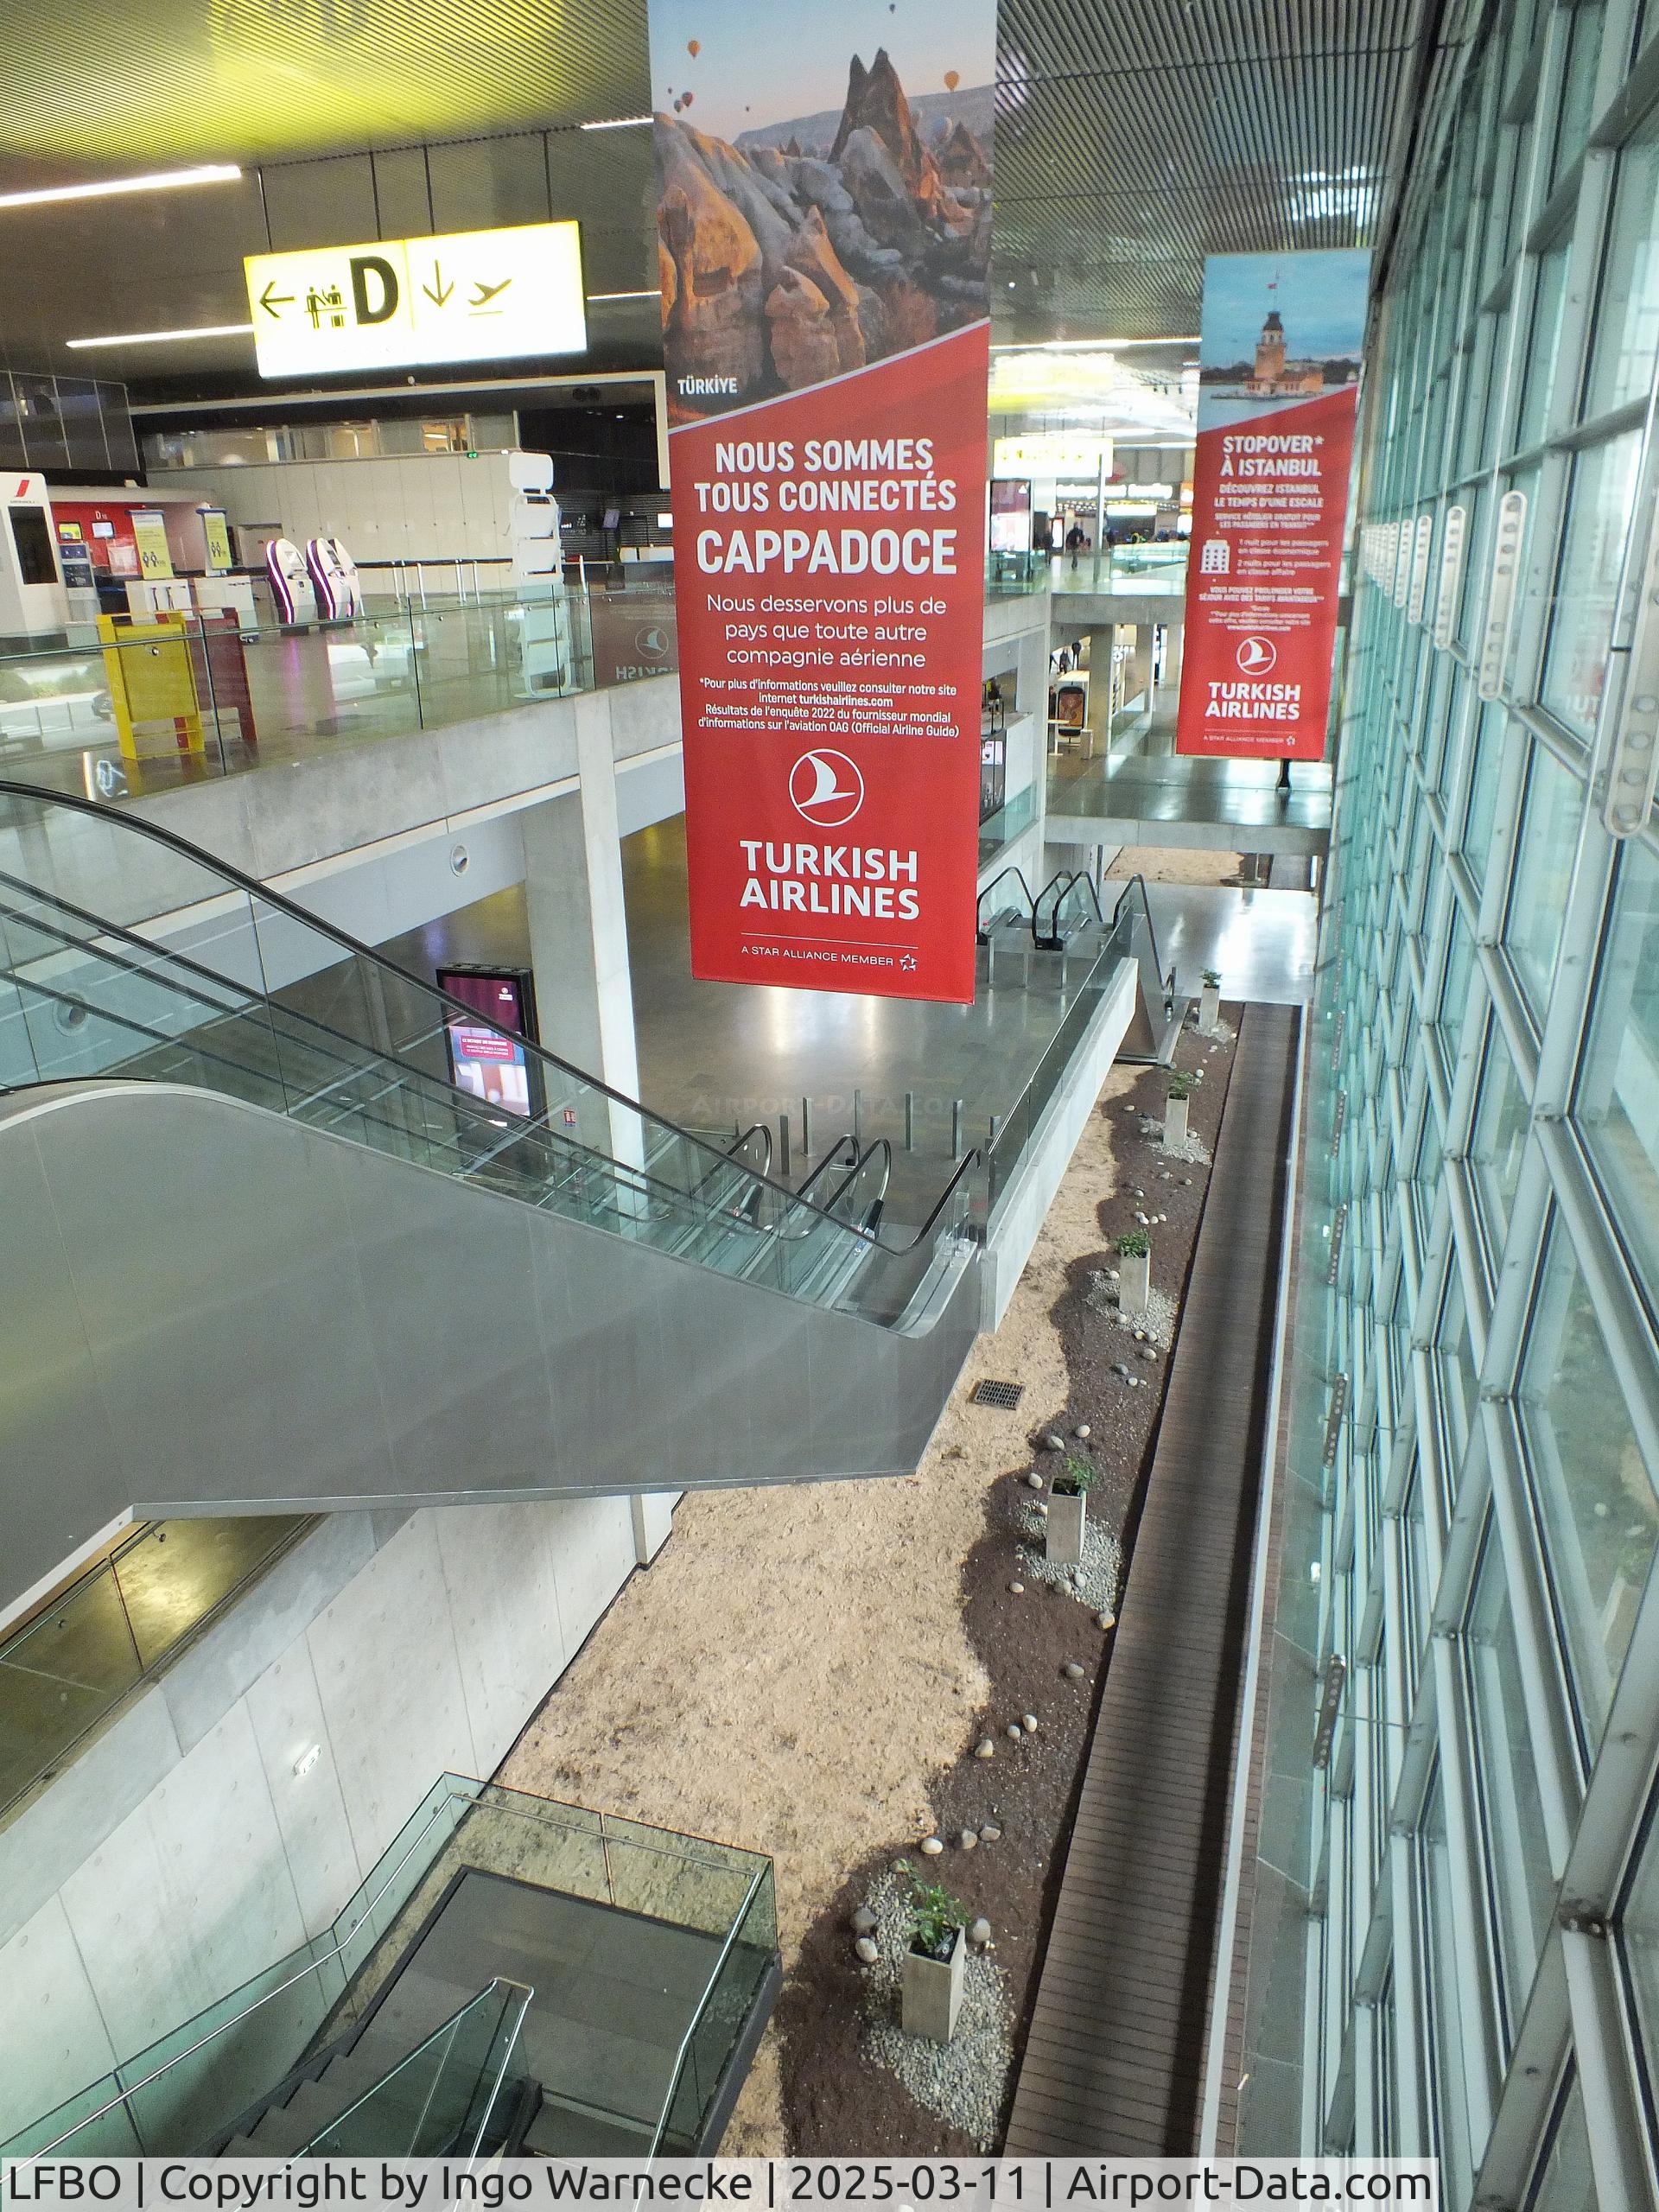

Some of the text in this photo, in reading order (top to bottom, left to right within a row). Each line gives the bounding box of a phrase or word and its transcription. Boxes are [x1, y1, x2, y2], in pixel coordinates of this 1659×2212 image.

[350, 256, 398, 325] D
[677, 375, 737, 394] TÜRKİYE
[716, 439, 933, 473] NOUS SOMMES
[1221, 454, 1321, 476] À ISTANBUL
[695, 471, 956, 512] TOUS CONNECTÉS
[697, 529, 957, 574] CAPPADOCE
[708, 594, 946, 616] Nous desservons plus de
[726, 623, 926, 641] pays que toute autre
[728, 648, 925, 667] compagnie aérienne
[728, 678, 747, 690] plus
[750, 678, 818, 690] d'informations
[821, 681, 856, 692] veuillez
[860, 683, 906, 693] consulter
[909, 684, 935, 695] notre
[938, 684, 957, 696] site
[1209, 683, 1300, 701] TURKISH
[760, 692, 893, 707] internet turkishairlines.com
[706, 704, 950, 722] Résultats de l'enquête 2022 du fournisseur mondial
[1205, 701, 1300, 720] AIRLINES
[699, 717, 765, 729] d'informations
[785, 720, 827, 731] l'aviation
[830, 721, 849, 732] OAG
[852, 721, 890, 734] (Official
[893, 724, 924, 735] Airline
[926, 725, 959, 737] Guide)
[741, 841, 917, 882] TURKISH
[741, 878, 918, 919] AIRLINES
[752, 947, 779, 956] STAR
[784, 950, 837, 961] ALLIANCE
[842, 955, 893, 965] MEMBER
